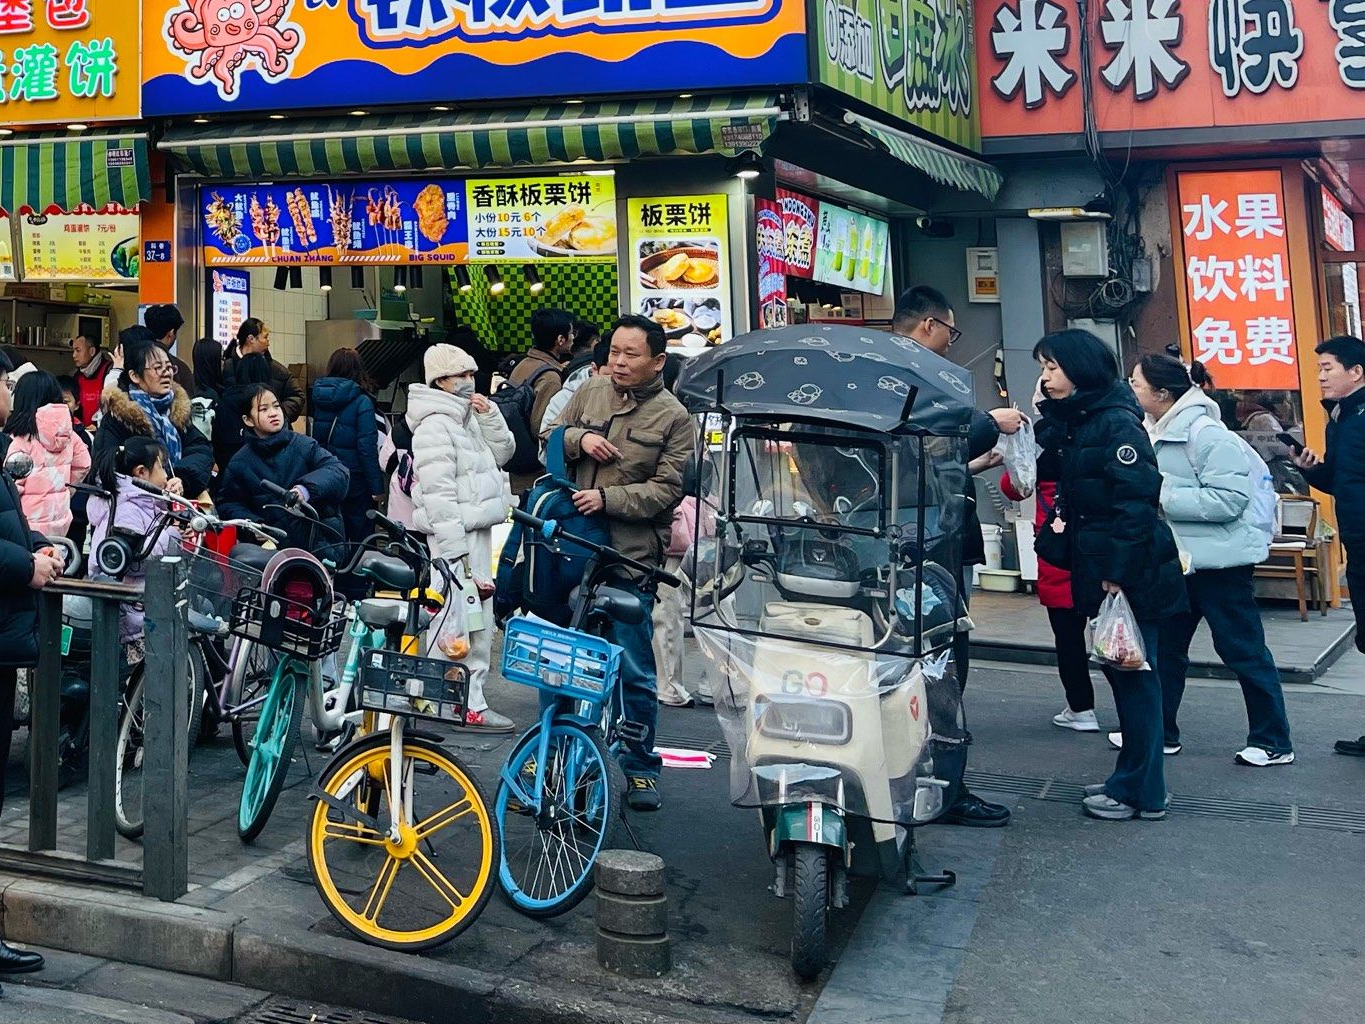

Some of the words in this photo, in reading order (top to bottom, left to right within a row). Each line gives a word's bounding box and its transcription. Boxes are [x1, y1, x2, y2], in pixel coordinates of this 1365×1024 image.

[472, 181, 592, 208] 香酥板栗饼
[640, 202, 711, 226] 板栗饼
[1183, 193, 1285, 240] 水果
[272, 255, 301, 263] CHUAN
[427, 253, 455, 261] SQUID
[1187, 254, 1291, 302] 饮料
[1192, 316, 1296, 366] 免费
[782, 670, 828, 697] GO
